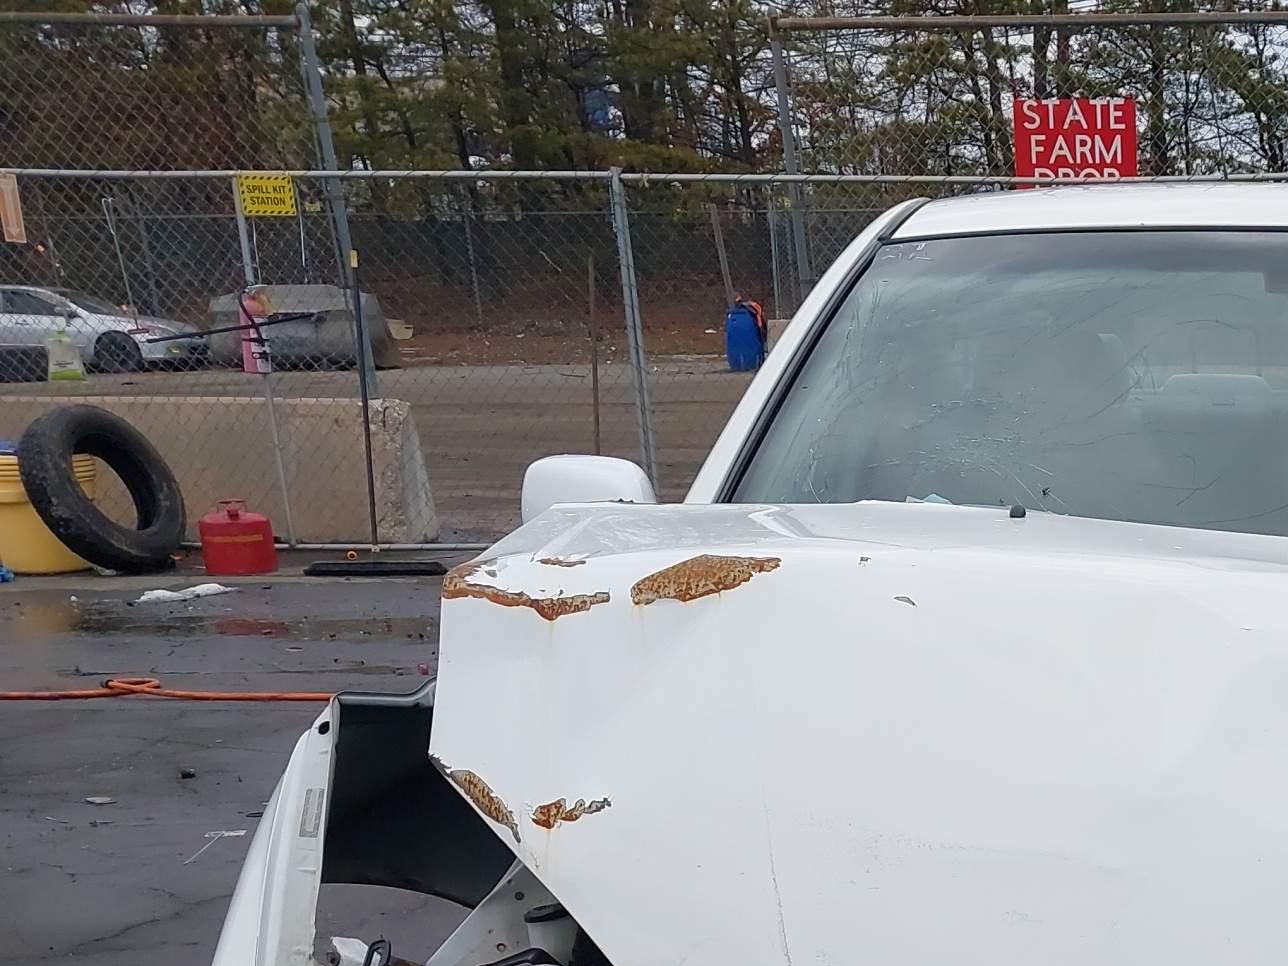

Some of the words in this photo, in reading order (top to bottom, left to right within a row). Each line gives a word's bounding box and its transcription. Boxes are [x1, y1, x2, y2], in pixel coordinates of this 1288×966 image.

[1022, 99, 1126, 129] STATE
[1030, 134, 1122, 164] FARM
[246, 185, 271, 194] SPILL
[272, 185, 286, 194] KIT
[249, 196, 286, 206] STATION
